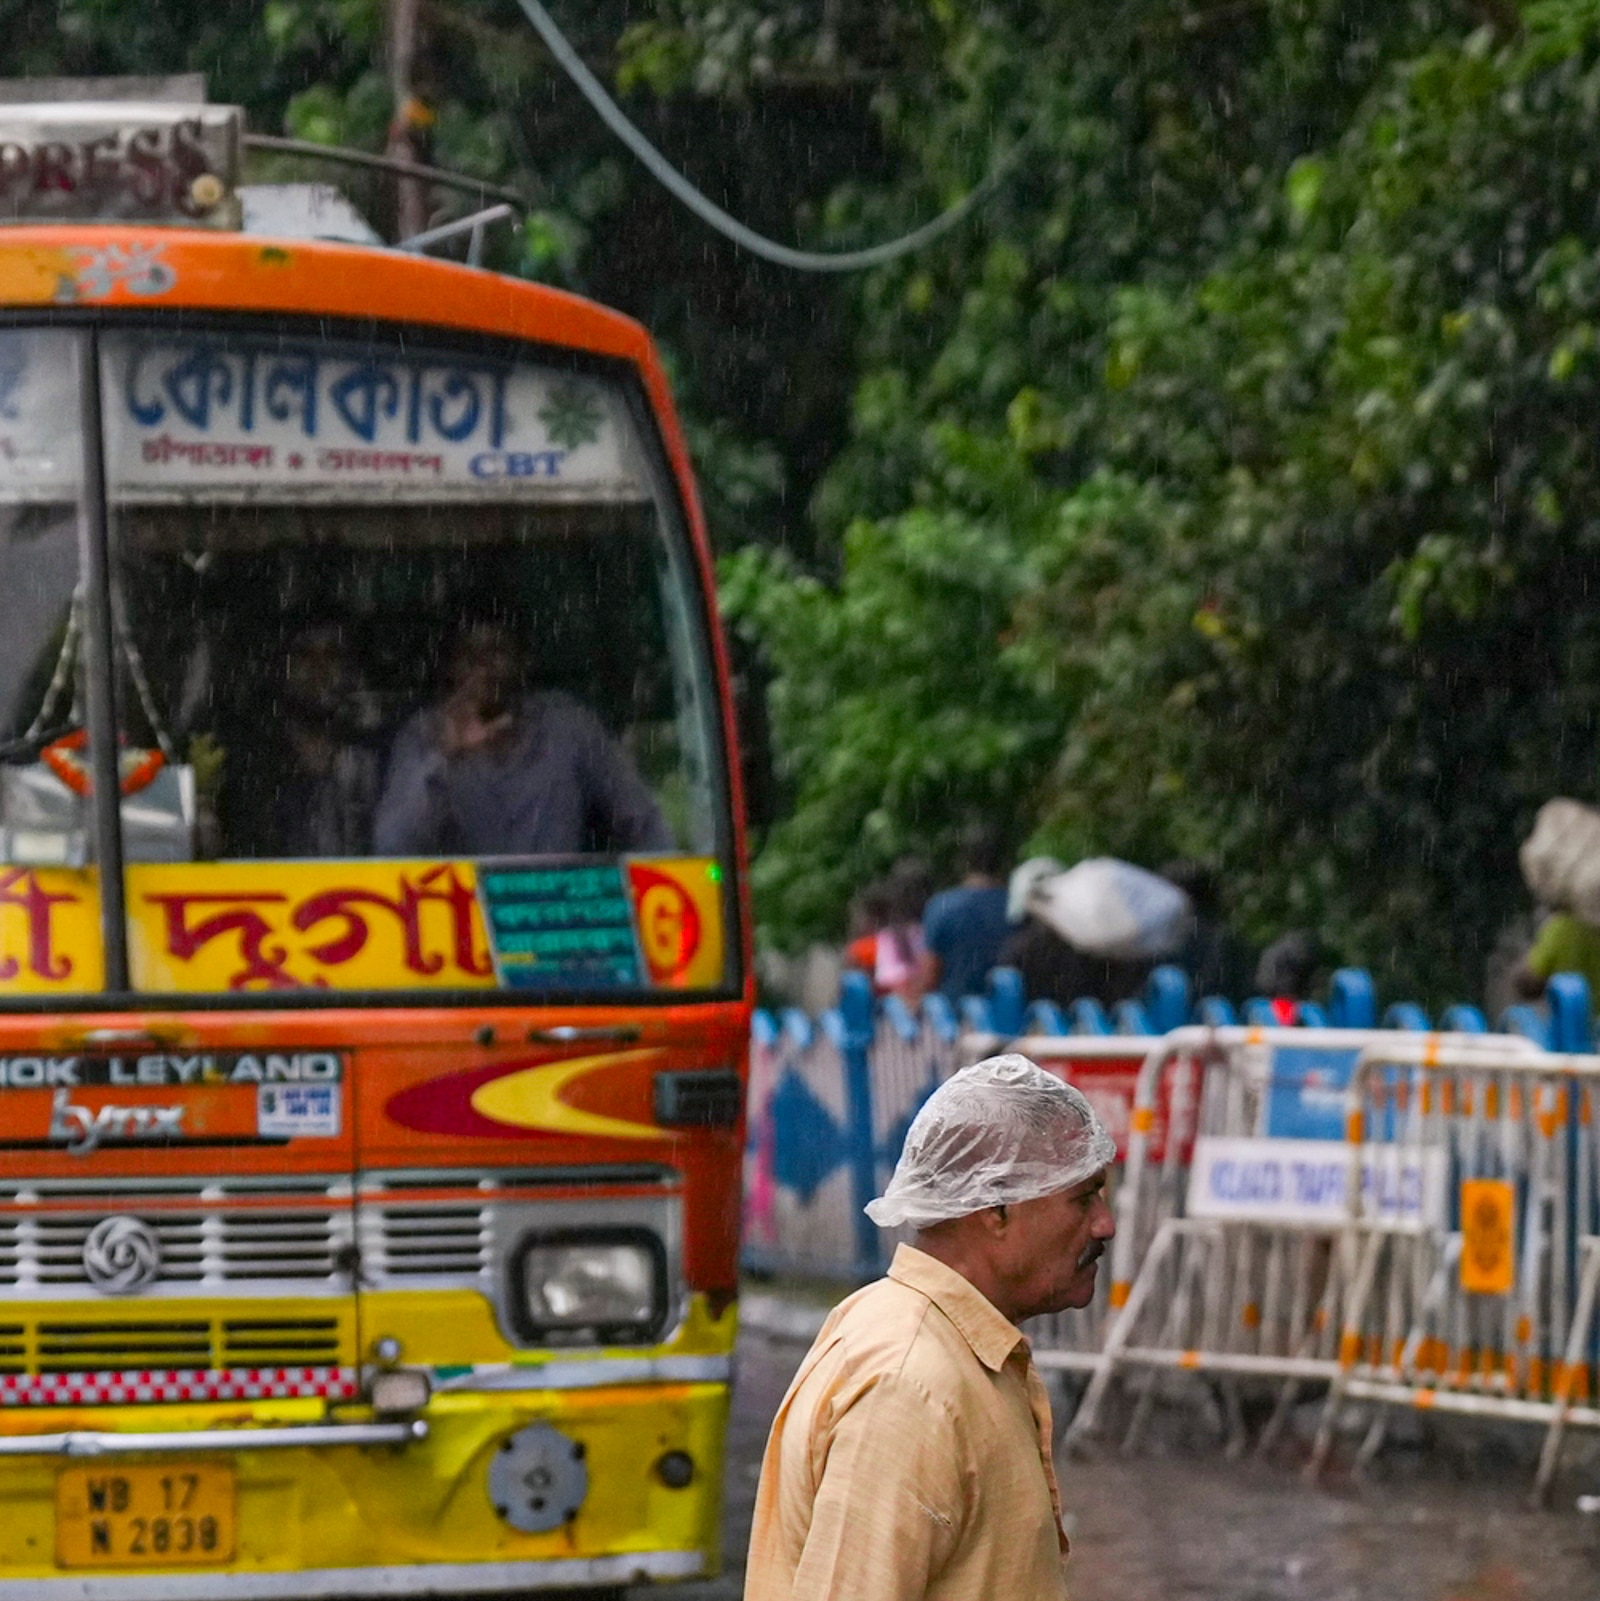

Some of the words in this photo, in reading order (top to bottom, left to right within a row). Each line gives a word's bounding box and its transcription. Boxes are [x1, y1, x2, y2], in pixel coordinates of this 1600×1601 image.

[469, 449, 566, 478] CBT
[110, 1053, 337, 1083] LEYLAND
[160, 1473, 198, 1510] 17
